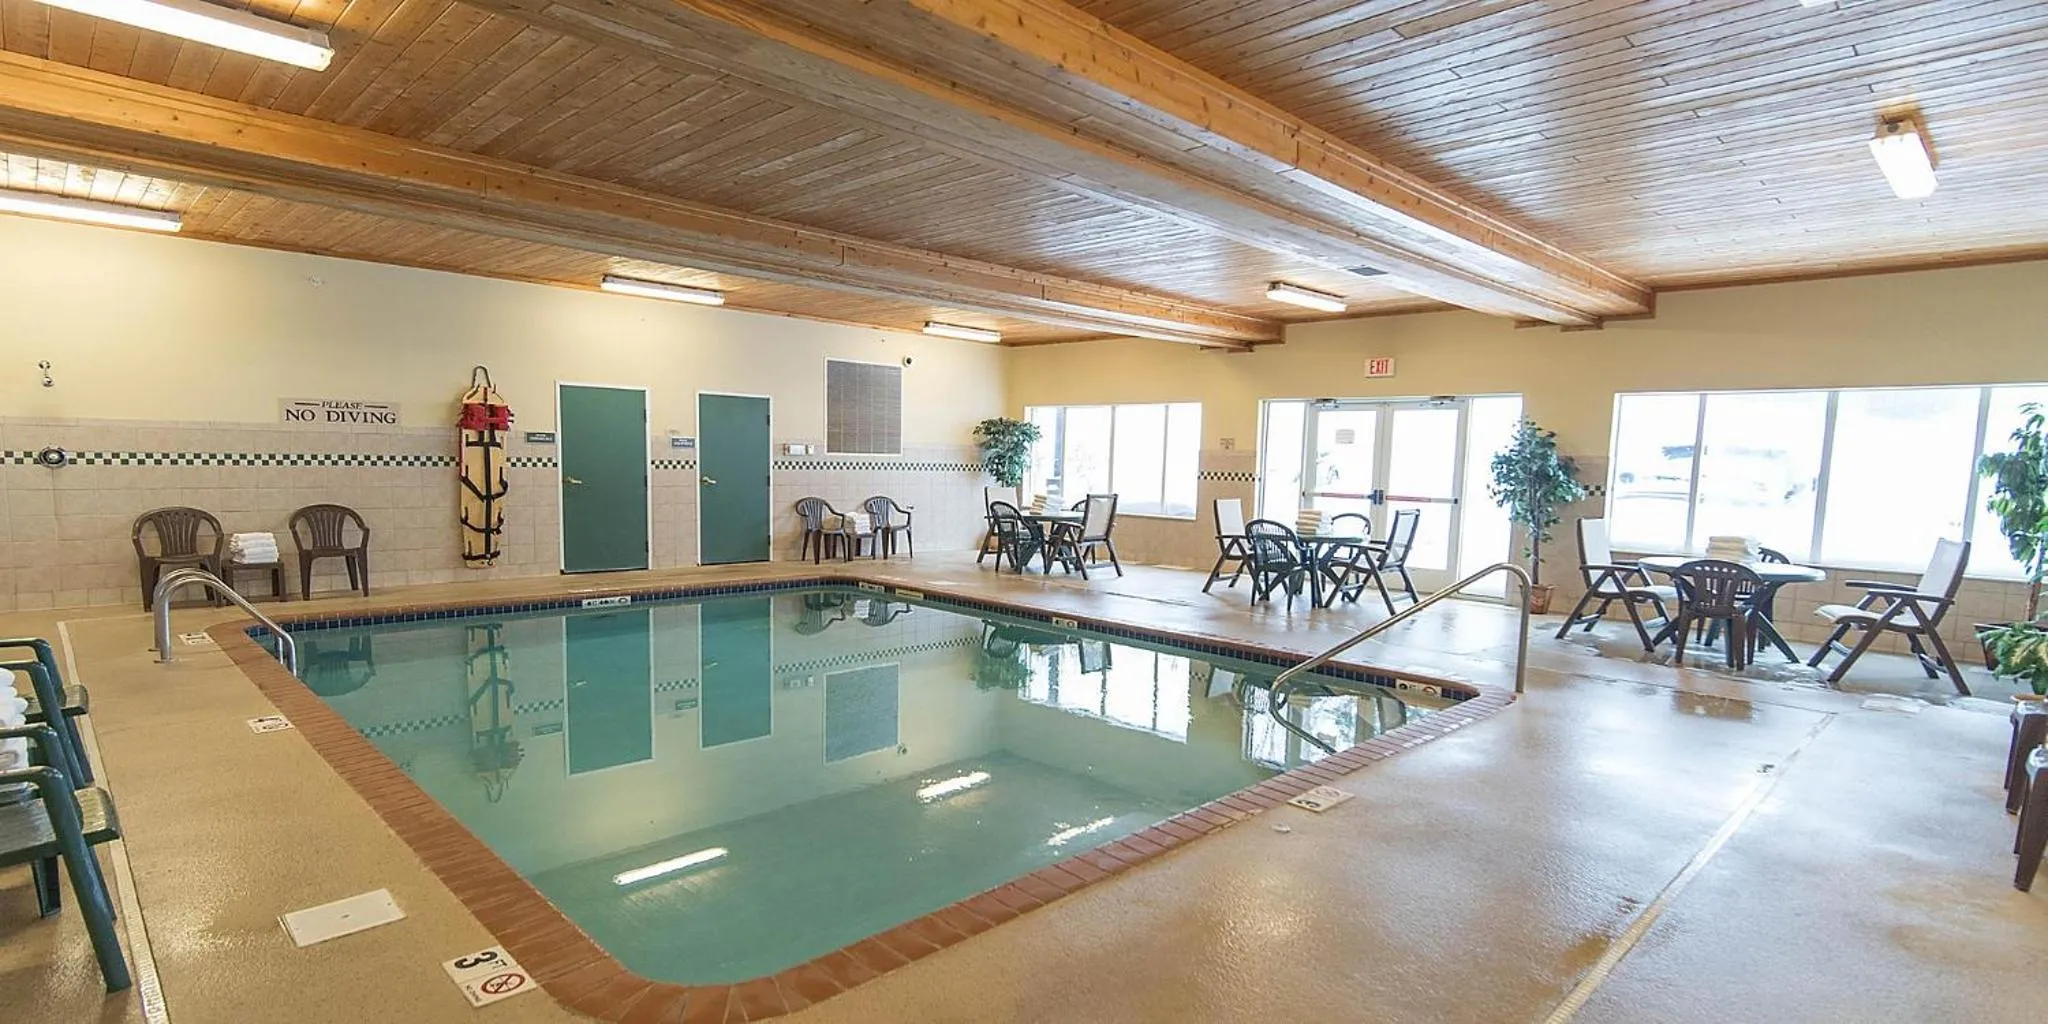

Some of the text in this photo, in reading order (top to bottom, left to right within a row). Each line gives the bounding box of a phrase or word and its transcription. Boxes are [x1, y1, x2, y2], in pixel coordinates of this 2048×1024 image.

[1370, 359, 1390, 375] EXIT
[322, 401, 363, 410] PLEASE
[285, 409, 397, 424] NO DIVING
[454, 951, 498, 969] 3
